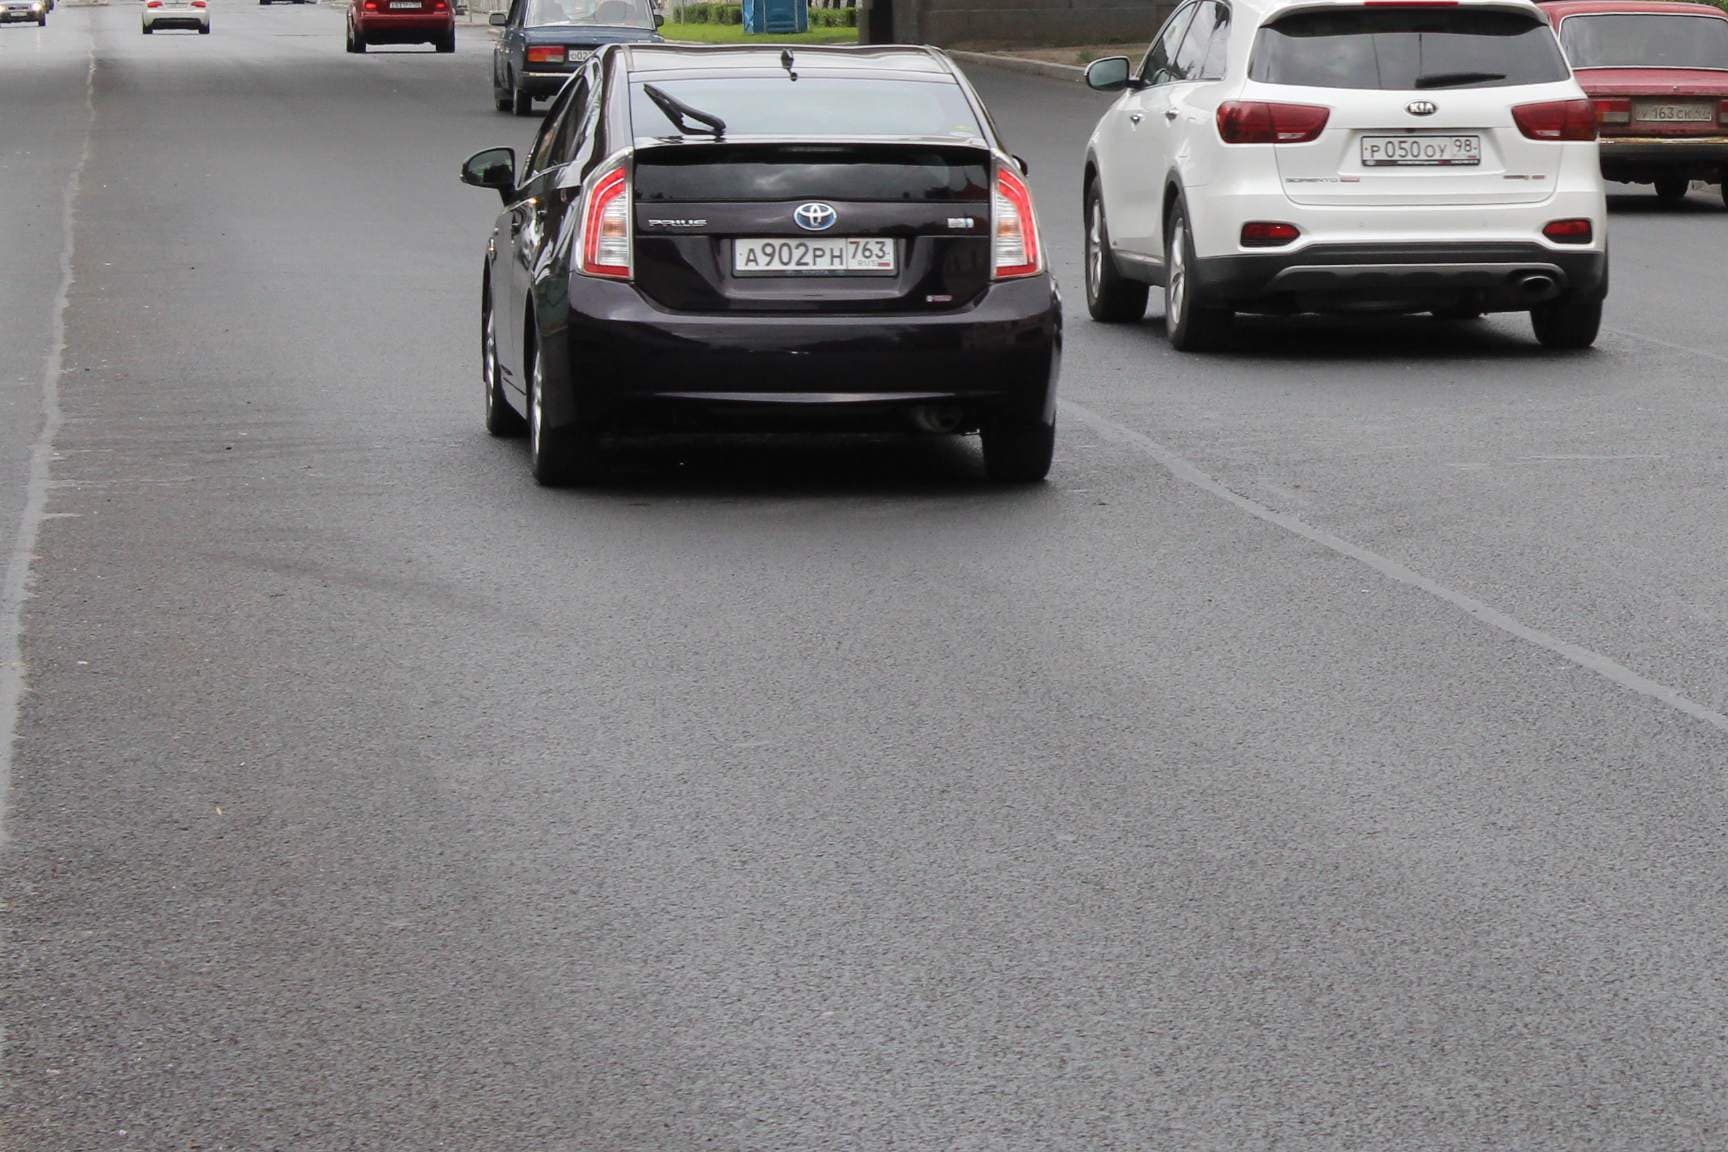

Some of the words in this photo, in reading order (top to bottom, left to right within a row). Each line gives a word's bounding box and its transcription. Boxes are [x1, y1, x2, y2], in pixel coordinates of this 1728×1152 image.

[1407, 102, 1436, 114] KIA
[1454, 138, 1473, 153] 98
[849, 240, 886, 260] 763
